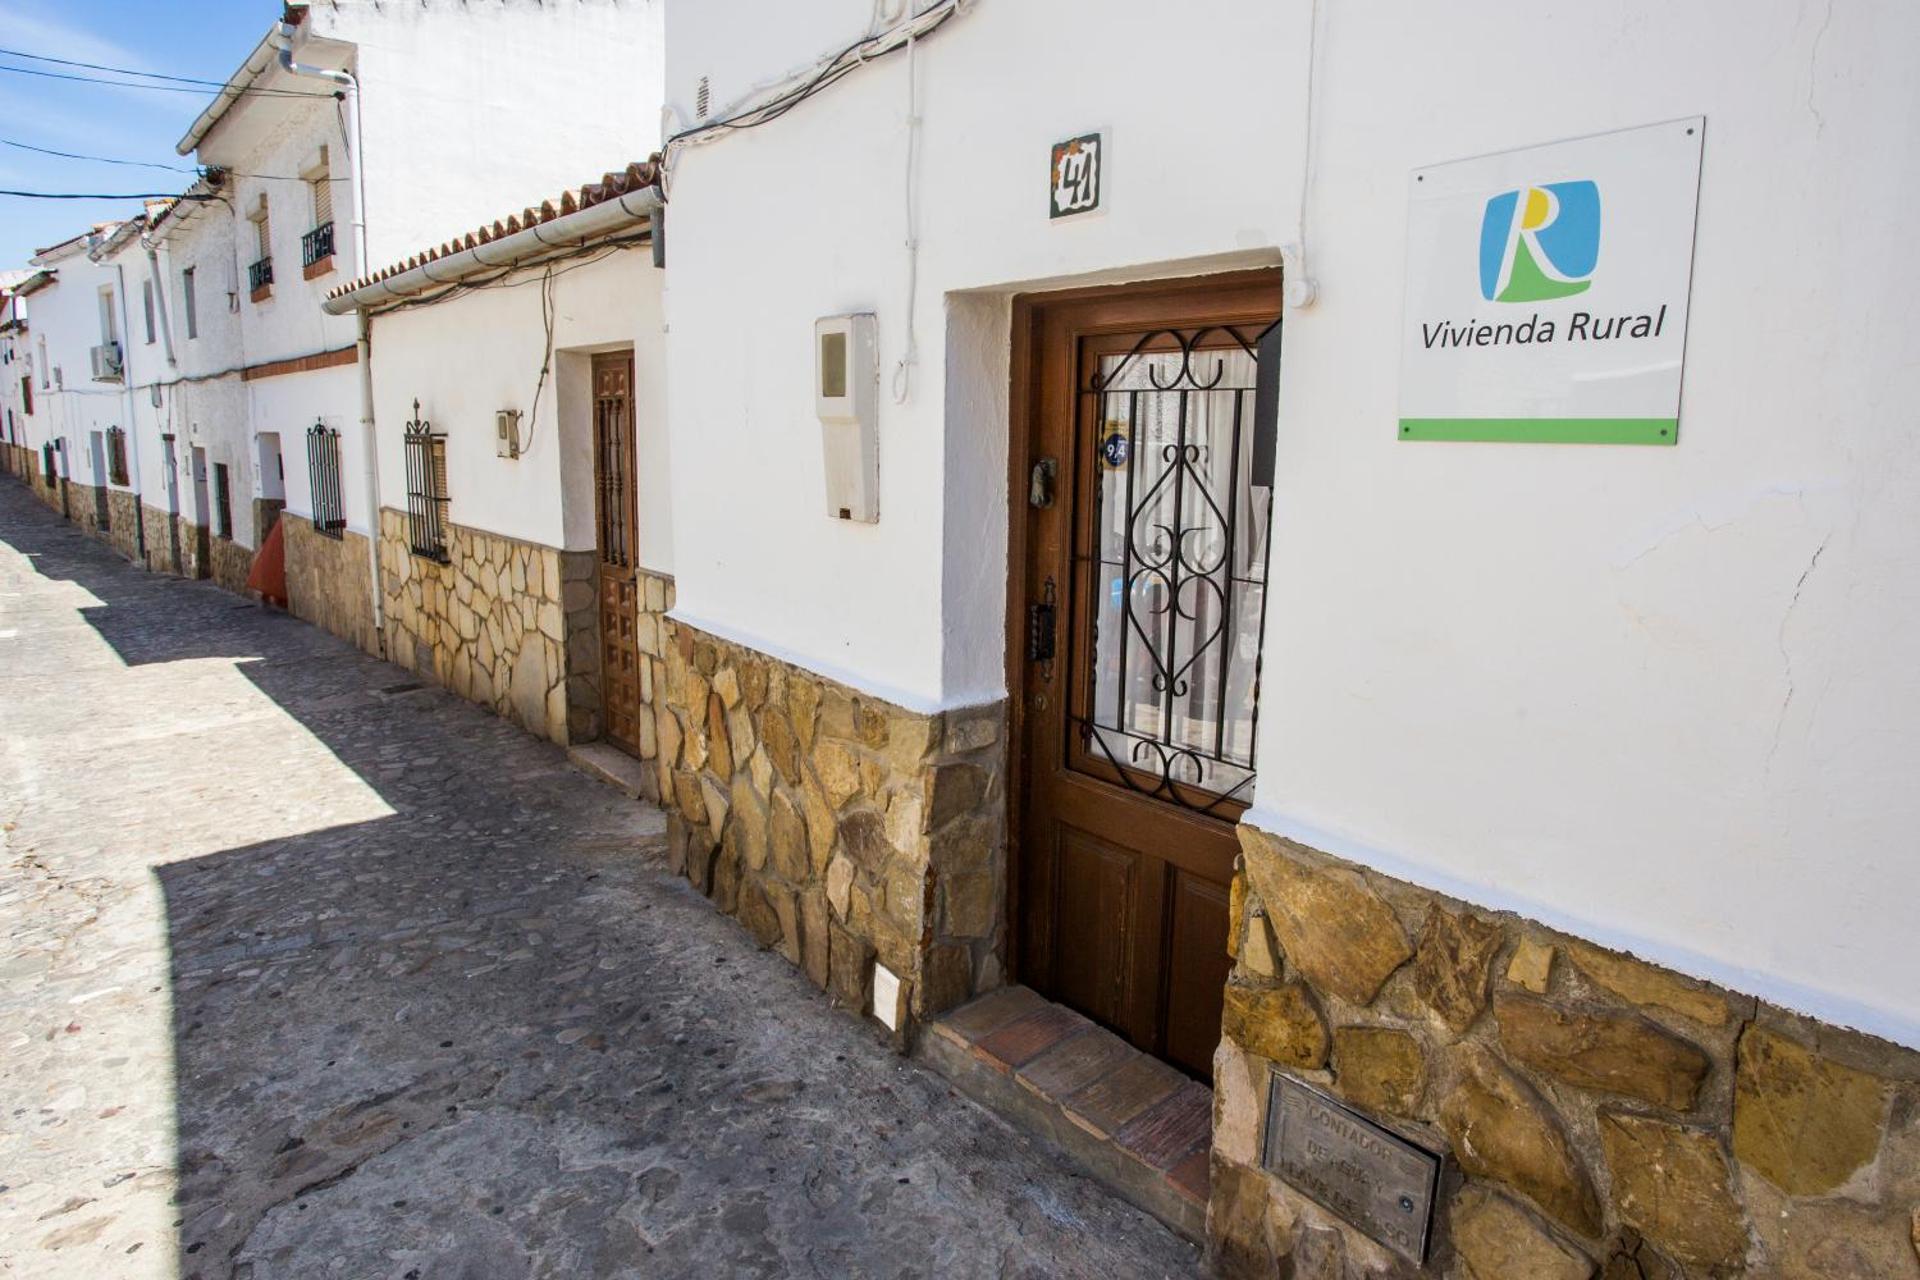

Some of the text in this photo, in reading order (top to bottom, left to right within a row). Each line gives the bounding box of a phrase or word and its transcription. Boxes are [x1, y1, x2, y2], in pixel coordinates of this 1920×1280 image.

[1063, 152, 1092, 205] 41
[1422, 304, 1667, 349] Vivienda Rural
[1308, 1104, 1393, 1163] CONTADOR
